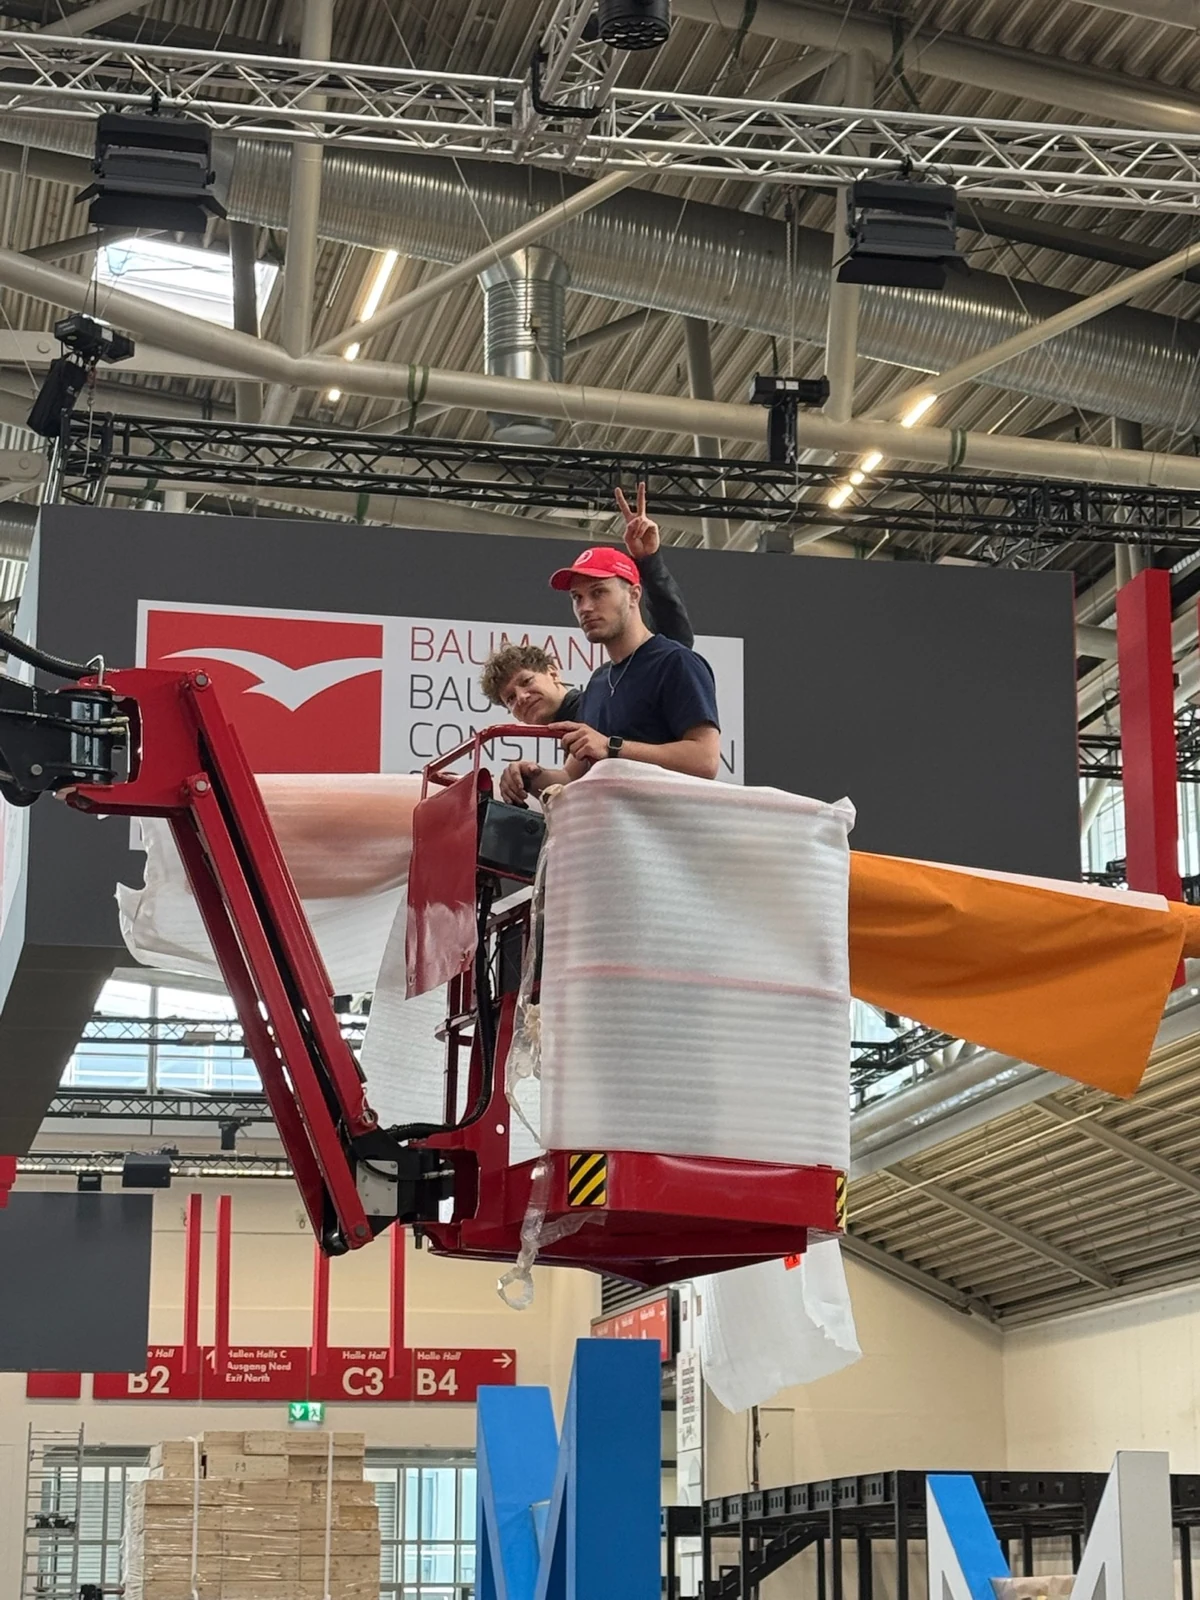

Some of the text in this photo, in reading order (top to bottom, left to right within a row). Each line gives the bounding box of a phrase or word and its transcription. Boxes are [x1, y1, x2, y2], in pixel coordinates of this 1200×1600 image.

[410, 626, 605, 672] BAUAN
[409, 721, 735, 775] CONSTN
[155, 1349, 175, 1359] Hall
[256, 1349, 278, 1359] Halls
[280, 1350, 287, 1359] C
[342, 1350, 388, 1361] Halle Hall
[417, 1351, 461, 1361] Halle Hall
[227, 1361, 292, 1373] Ausgang Nord
[127, 1365, 170, 1394] B2
[225, 1373, 271, 1383] Exit North
[342, 1366, 384, 1396] C3
[416, 1368, 459, 1396] B4
